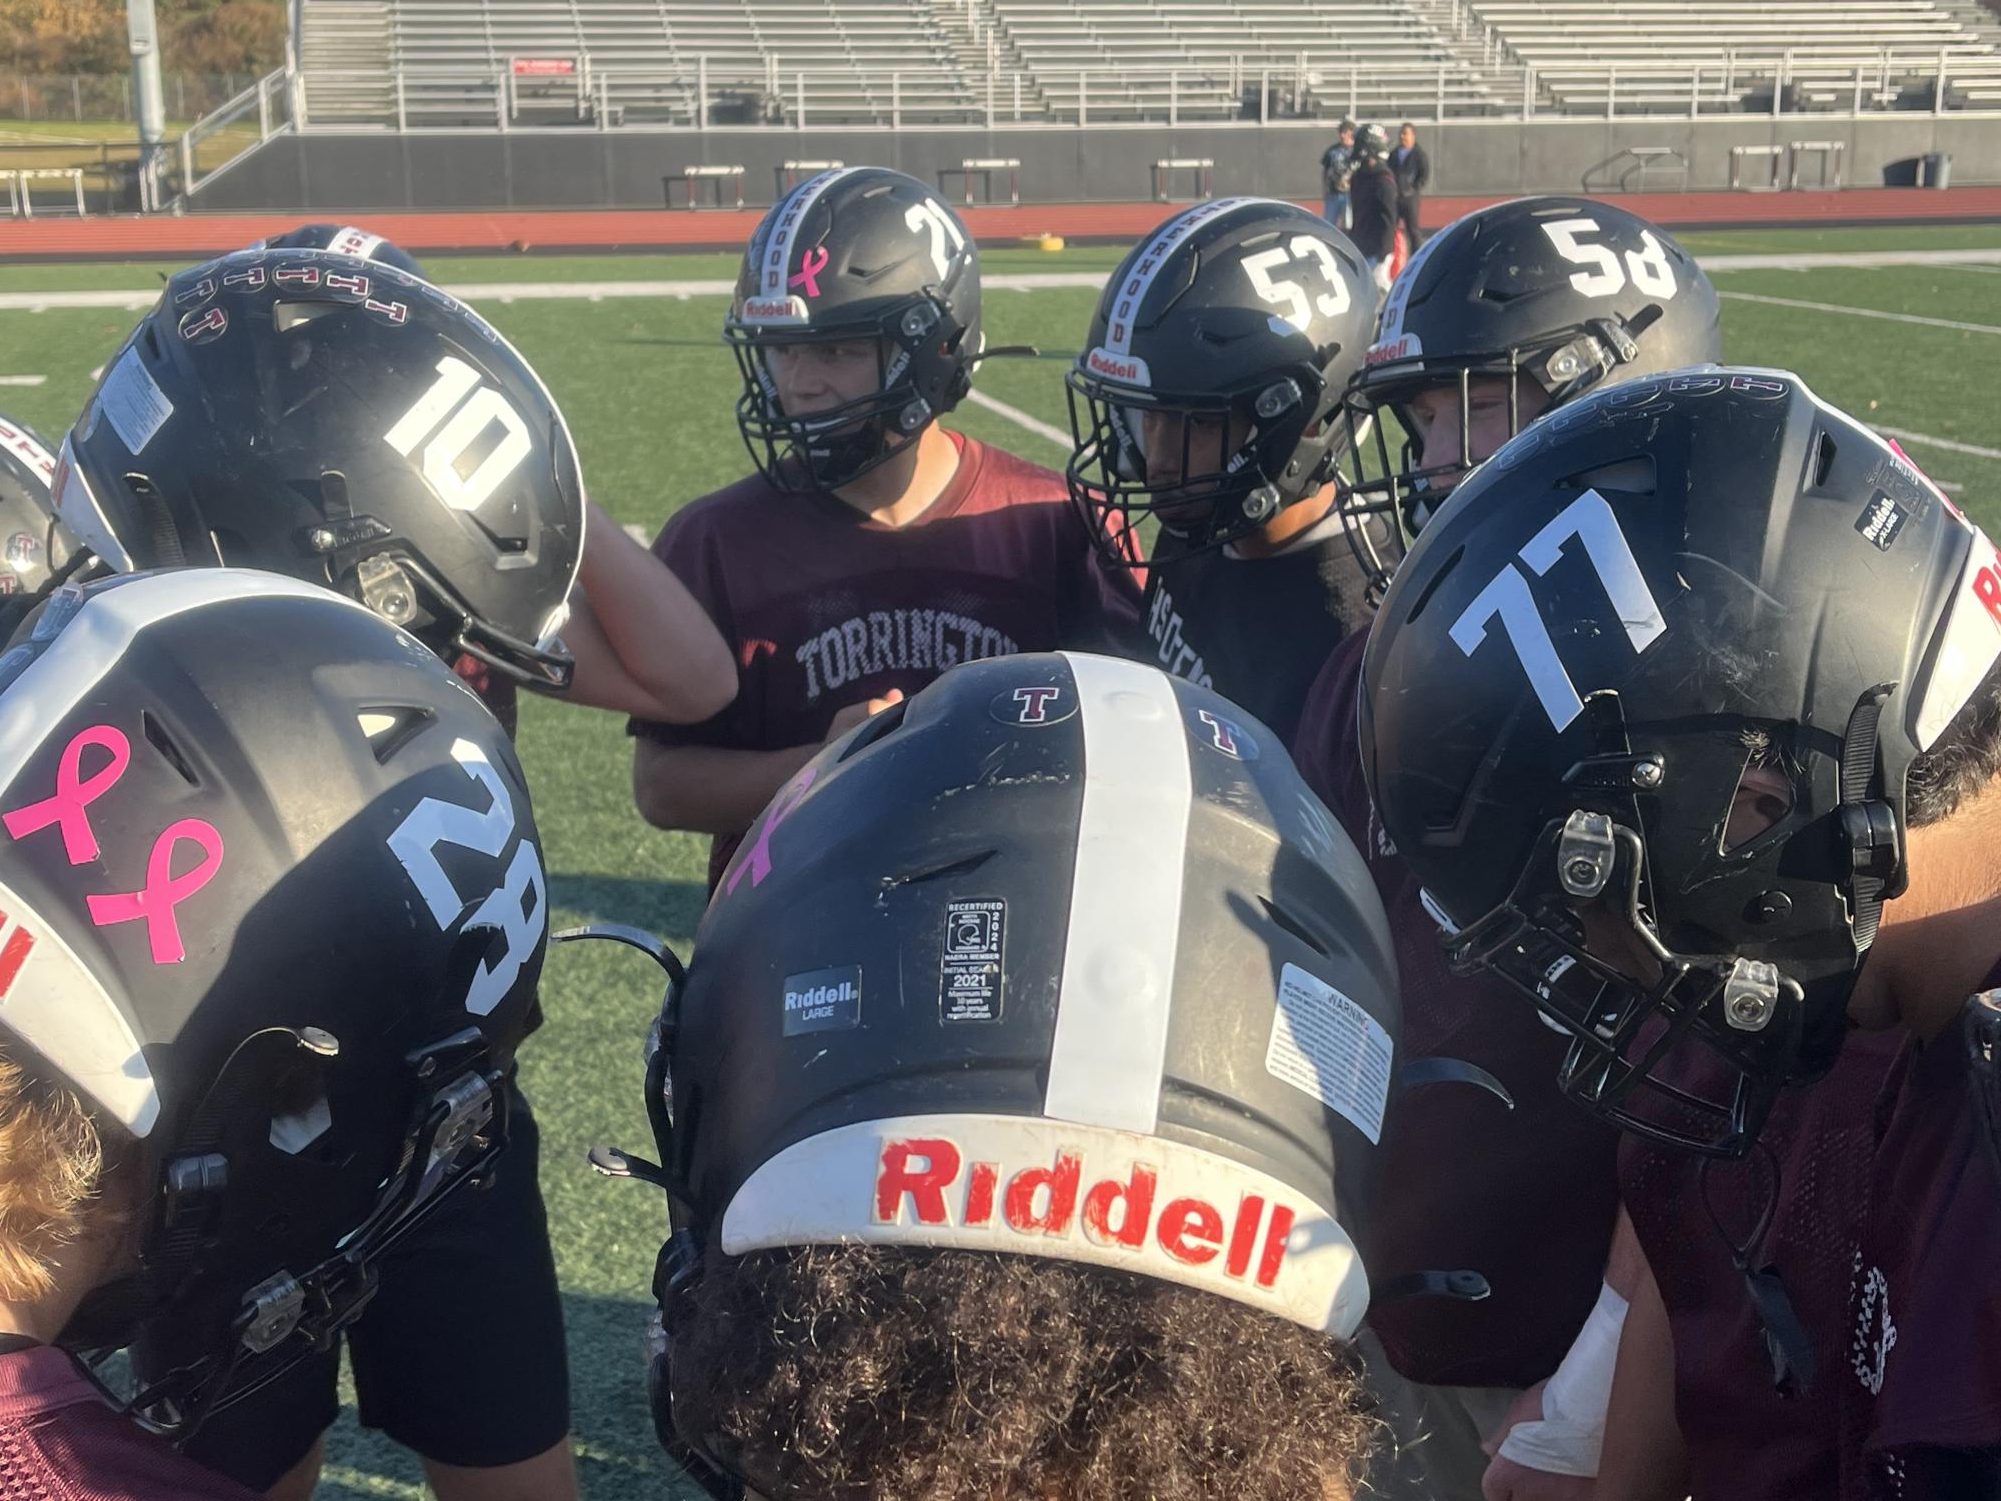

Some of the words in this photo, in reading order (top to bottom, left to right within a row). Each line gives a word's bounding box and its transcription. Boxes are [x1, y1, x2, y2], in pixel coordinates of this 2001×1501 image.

[904, 197, 972, 281] 21
[276, 267, 319, 284] T
[1540, 218, 1677, 300] 58
[224, 267, 264, 286] T
[327, 274, 369, 296] T
[1240, 235, 1351, 337] 53
[184, 308, 225, 339] T
[365, 299, 407, 323] T
[746, 302, 793, 317] Riddell
[1090, 354, 1137, 379] Riddell
[383, 356, 532, 511] 10
[1862, 498, 1895, 541] Riddell
[1448, 488, 1667, 733] 77
[1013, 687, 1060, 723] T
[1199, 709, 1241, 755] T
[386, 737, 546, 1016] 28
[948, 902, 1003, 911] RECERTIFIED
[990, 911, 1000, 952] 2024
[953, 974, 986, 987] 2021
[968, 964, 999, 973] SEAN
[784, 982, 852, 1011] Riddell
[803, 1006, 834, 1020] LARGE
[1328, 993, 1370, 1031] WARNING
[872, 1136, 1297, 1293] Riddell
